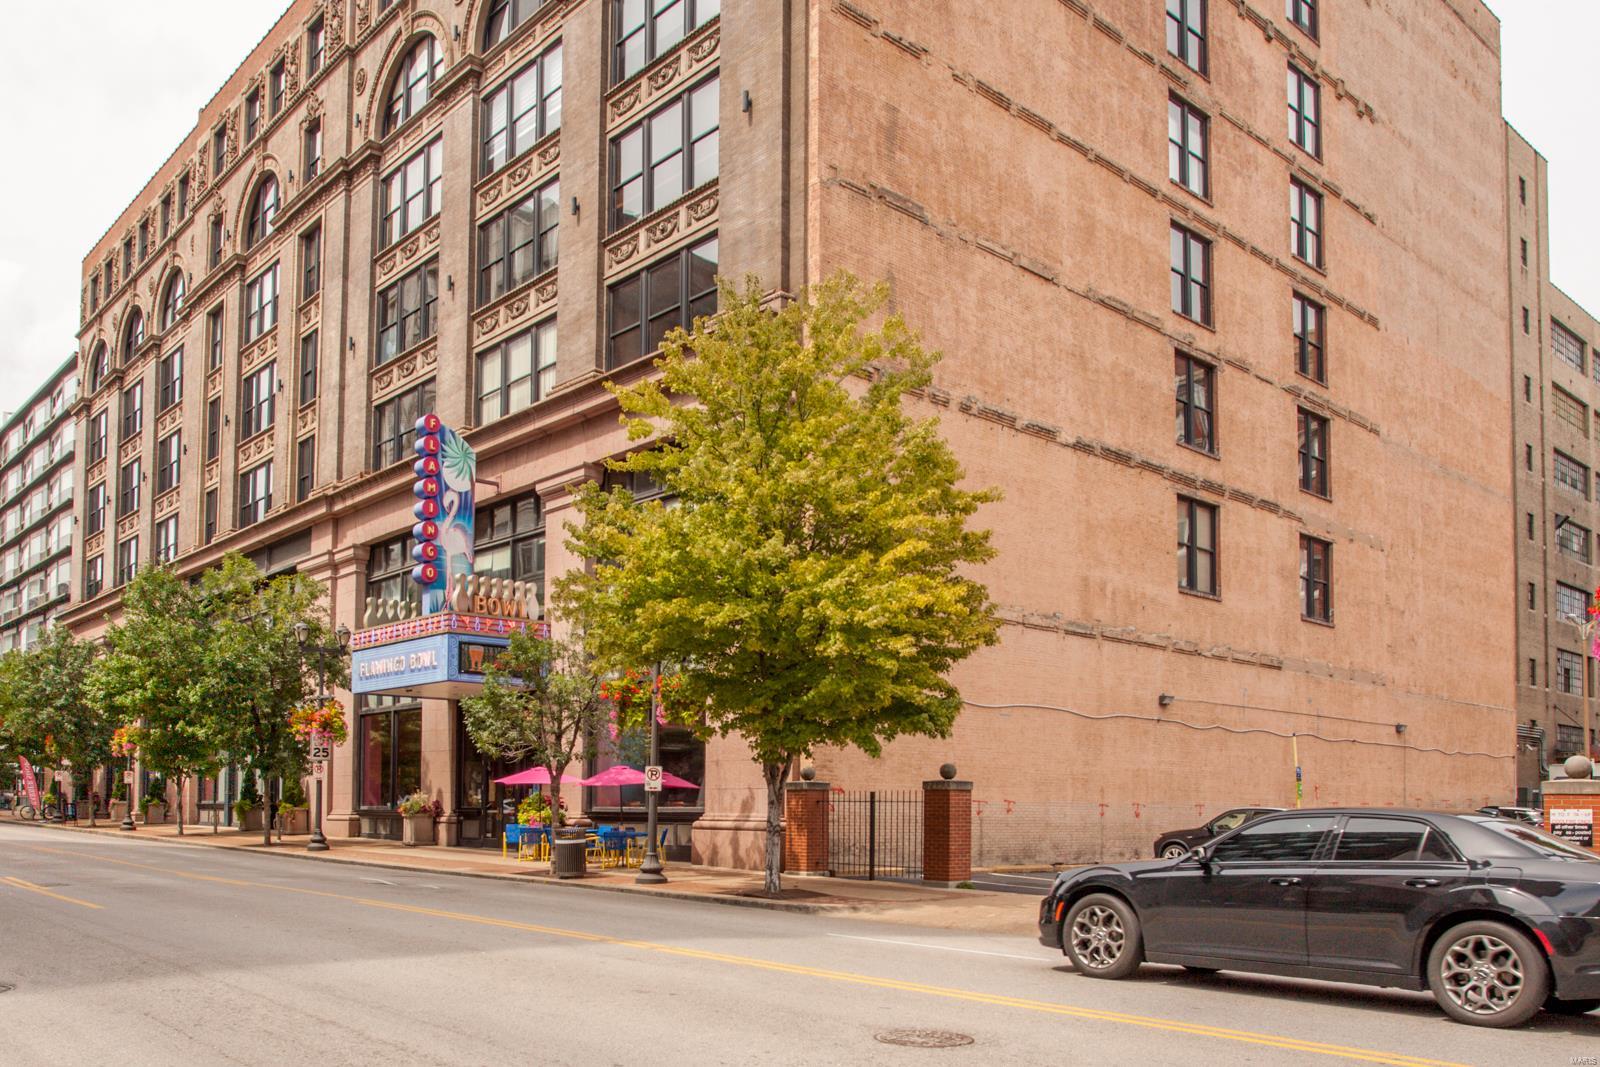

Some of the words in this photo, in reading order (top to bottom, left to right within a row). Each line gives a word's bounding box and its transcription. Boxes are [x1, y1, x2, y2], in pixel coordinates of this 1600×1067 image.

[474, 593, 528, 619] BOWL
[359, 655, 406, 677] FLAMINGO
[410, 650, 438, 669] BOWL
[313, 747, 329, 758] 25
